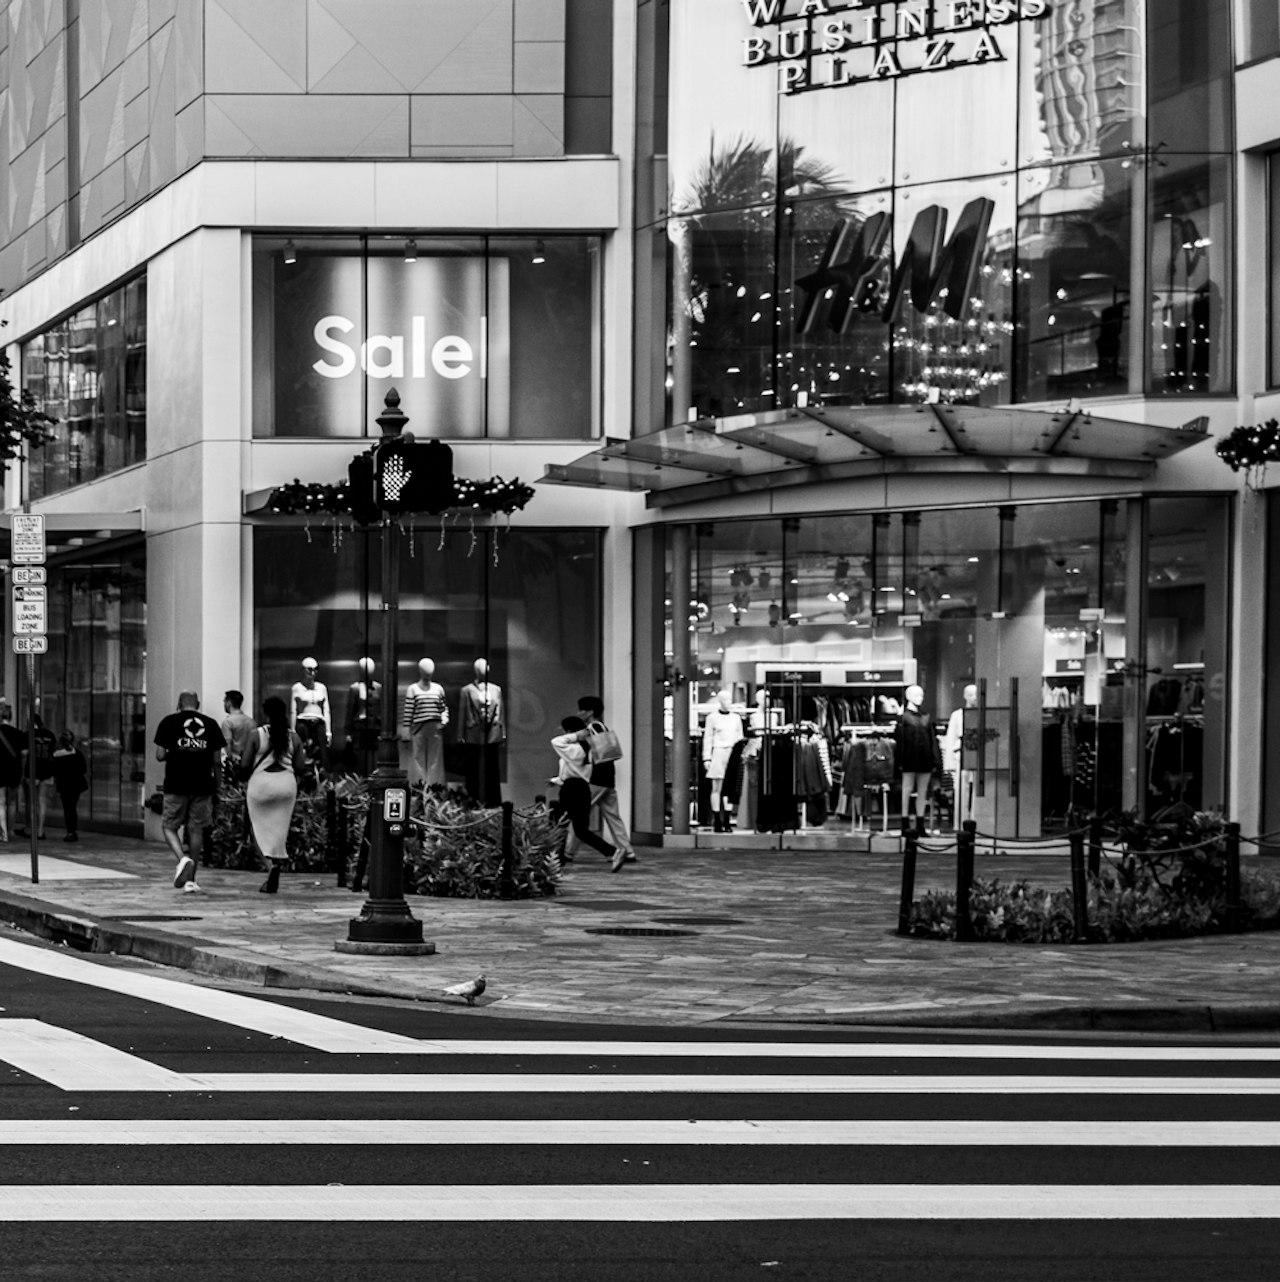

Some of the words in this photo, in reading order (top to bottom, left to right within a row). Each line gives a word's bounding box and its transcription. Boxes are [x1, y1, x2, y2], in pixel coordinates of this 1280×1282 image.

[741, 0, 1046, 66] BUSINESS
[777, 28, 1002, 94] PLAZA
[794, 196, 996, 335] H&M
[17, 571, 42, 581] BEGIN
[23, 604, 37, 612] BUS
[17, 613, 43, 621] LOADING
[21, 622, 38, 630] ZONE
[17, 640, 43, 650] BEGIN
